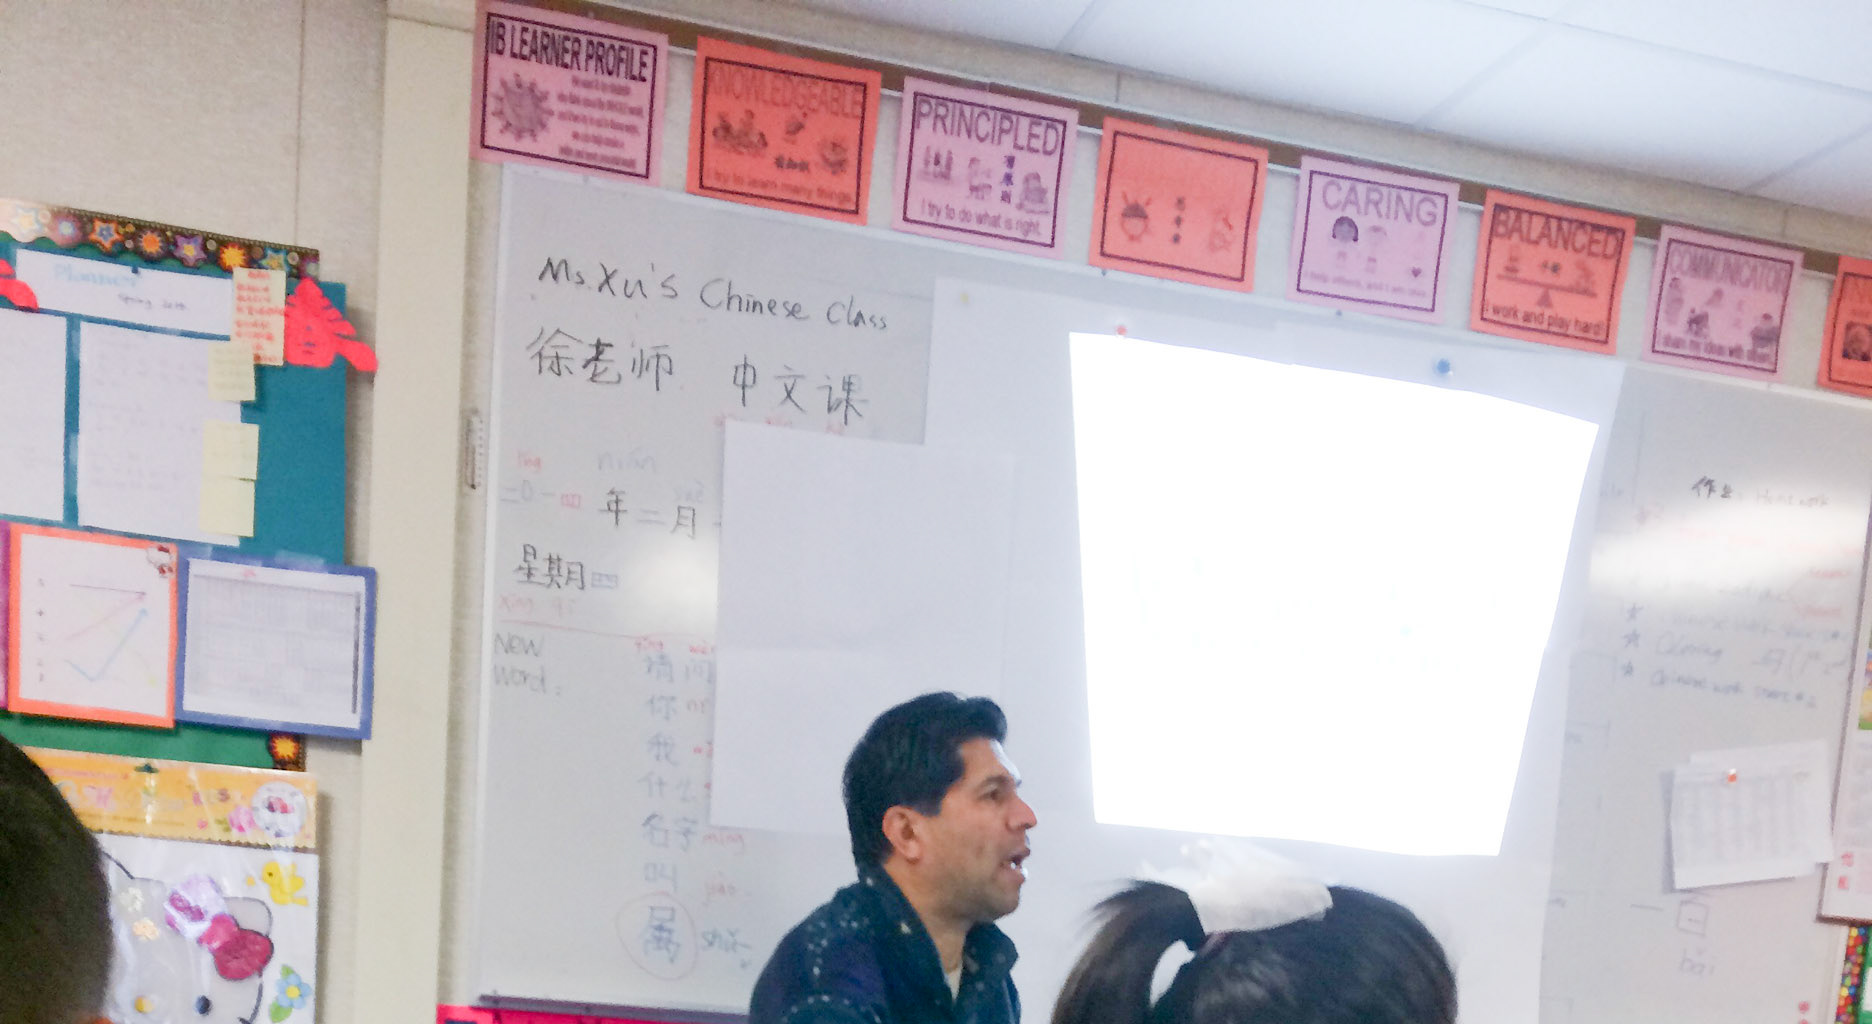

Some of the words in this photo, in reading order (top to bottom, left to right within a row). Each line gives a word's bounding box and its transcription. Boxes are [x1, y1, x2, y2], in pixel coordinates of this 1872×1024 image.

[488, 18, 506, 57] IB
[510, 22, 582, 71] LEARNER
[583, 40, 649, 83] PROFILE
[708, 63, 863, 120] KNOWLEDGEABLE
[915, 96, 1062, 158] PRINCIPLED
[927, 202, 943, 221] try
[944, 203, 957, 221] to
[958, 206, 973, 223] do
[975, 208, 1002, 228] what
[1321, 178, 1438, 227] CARING
[1492, 208, 1623, 259] BALANCED
[1669, 245, 1790, 294] COMMUNICATOR
[699, 276, 810, 321] Chinese
[825, 293, 889, 331] Class
[1492, 304, 1519, 320] work
[1521, 309, 1545, 325] and
[1547, 313, 1571, 333] play
[525, 325, 674, 393] 徐老师
[731, 353, 870, 426] 中文课
